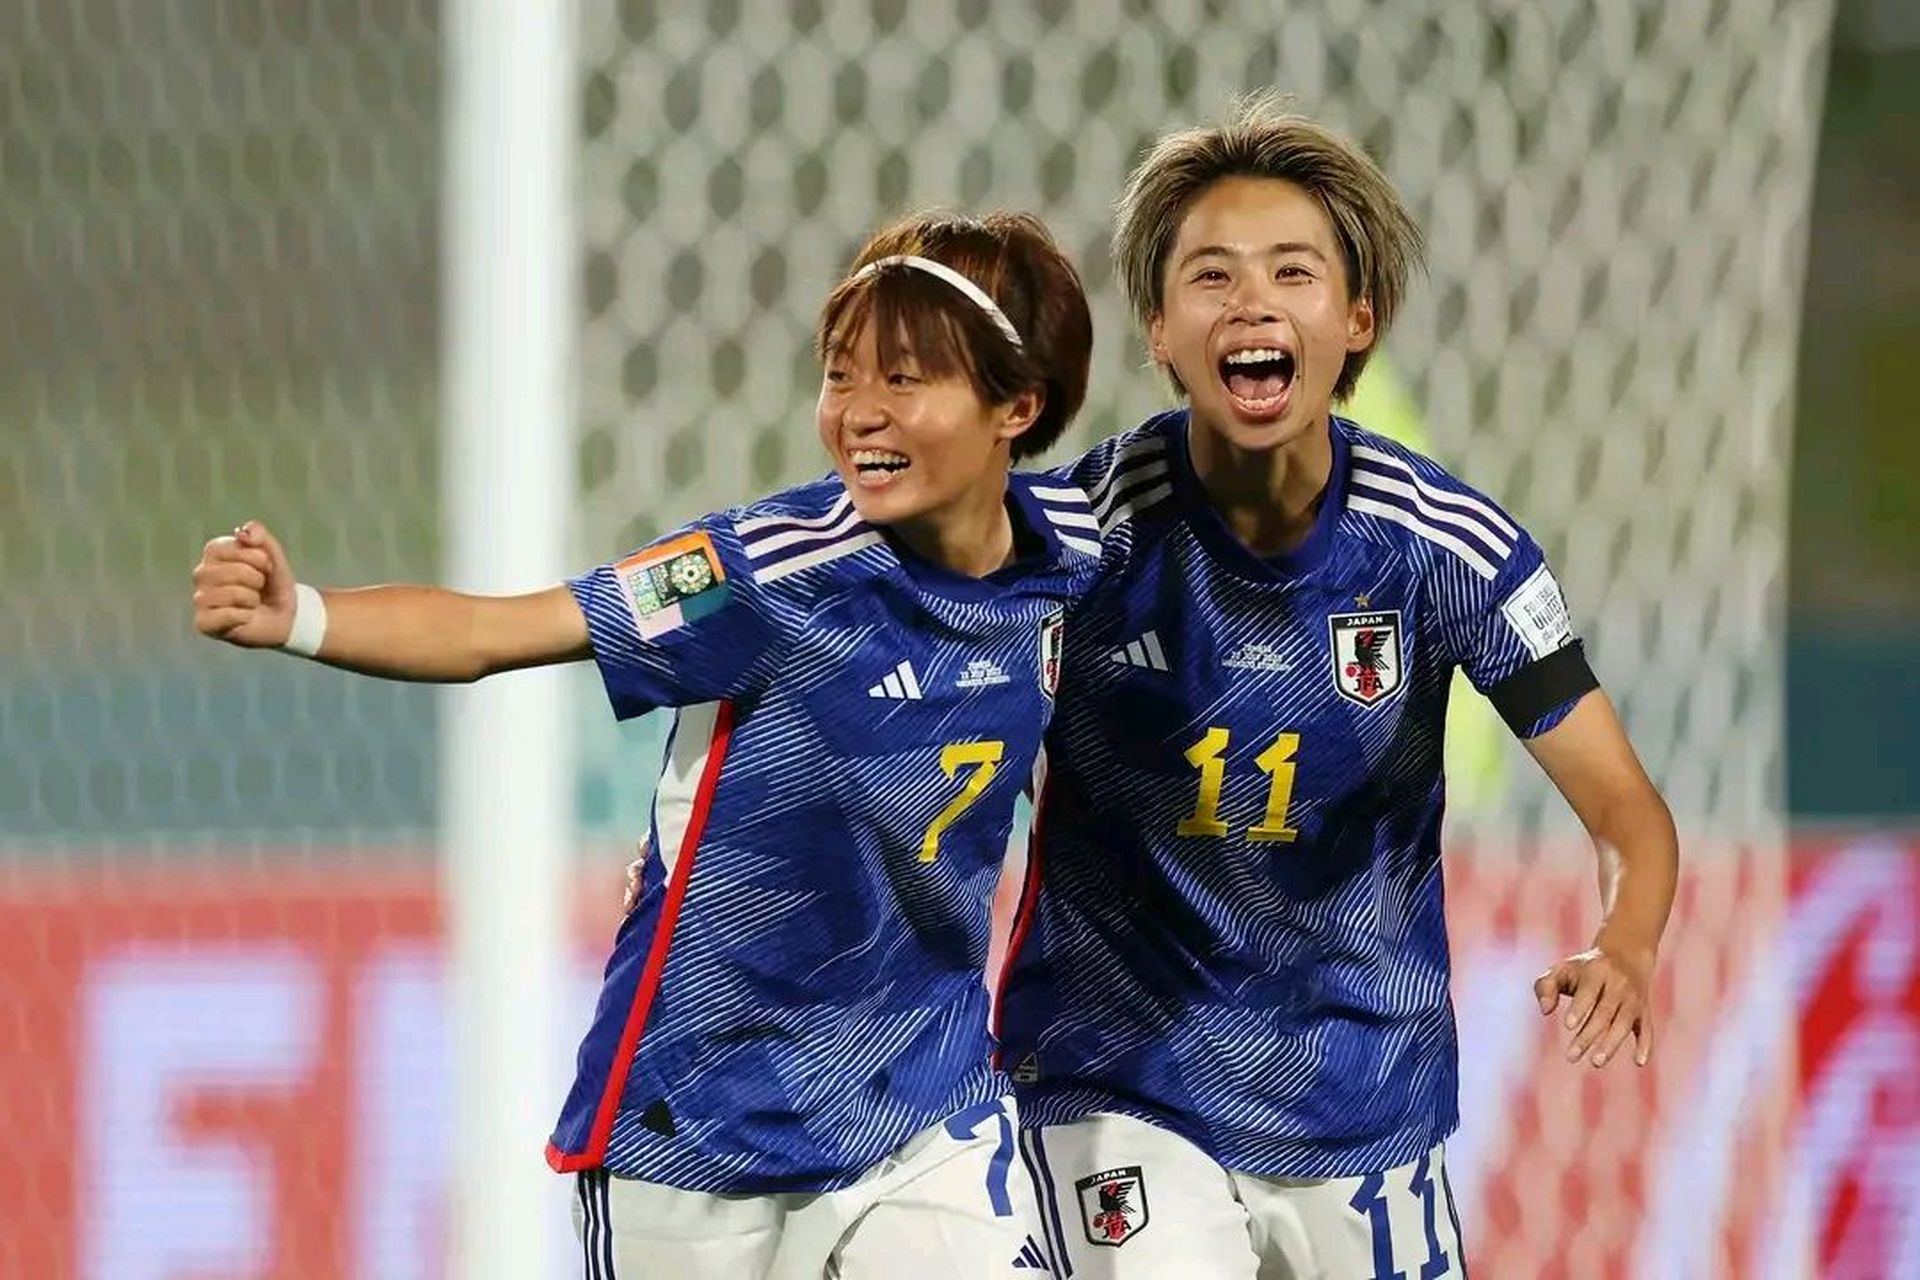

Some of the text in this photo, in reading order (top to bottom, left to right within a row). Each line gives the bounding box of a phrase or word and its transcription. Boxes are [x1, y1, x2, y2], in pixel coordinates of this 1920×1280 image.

[1346, 616, 1383, 626] JAPAN
[1353, 678, 1384, 692] JFA
[917, 741, 1004, 863] 7
[1177, 727, 1300, 842] 11
[943, 1099, 1015, 1216] 7
[1091, 1169, 1127, 1185] JAPAN
[1349, 1154, 1449, 1280] 11
